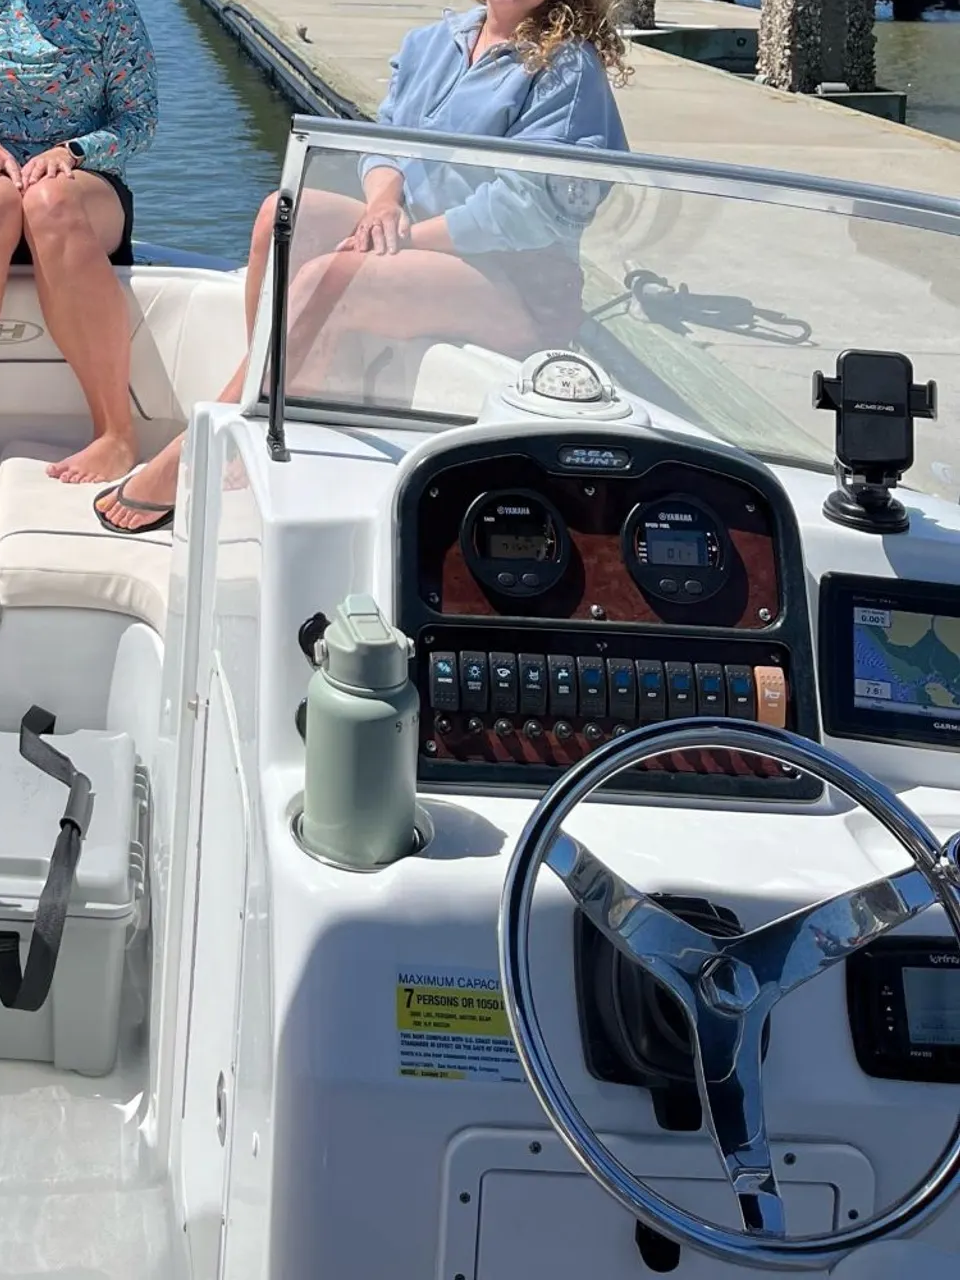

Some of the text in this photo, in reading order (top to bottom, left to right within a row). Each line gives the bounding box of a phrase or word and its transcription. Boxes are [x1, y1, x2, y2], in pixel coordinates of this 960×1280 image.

[573, 449, 614, 458] SEA
[565, 456, 622, 466] HUNT
[504, 506, 531, 515] YAMAHA
[666, 513, 692, 522] YAMAHA
[933, 722, 960, 731] GARM
[398, 973, 500, 990] MAXIMUM CAPACI
[404, 988, 414, 1008] 7
[416, 994, 459, 1008] PERSONS
[462, 997, 475, 1008] OR
[476, 998, 499, 1010] 1050
